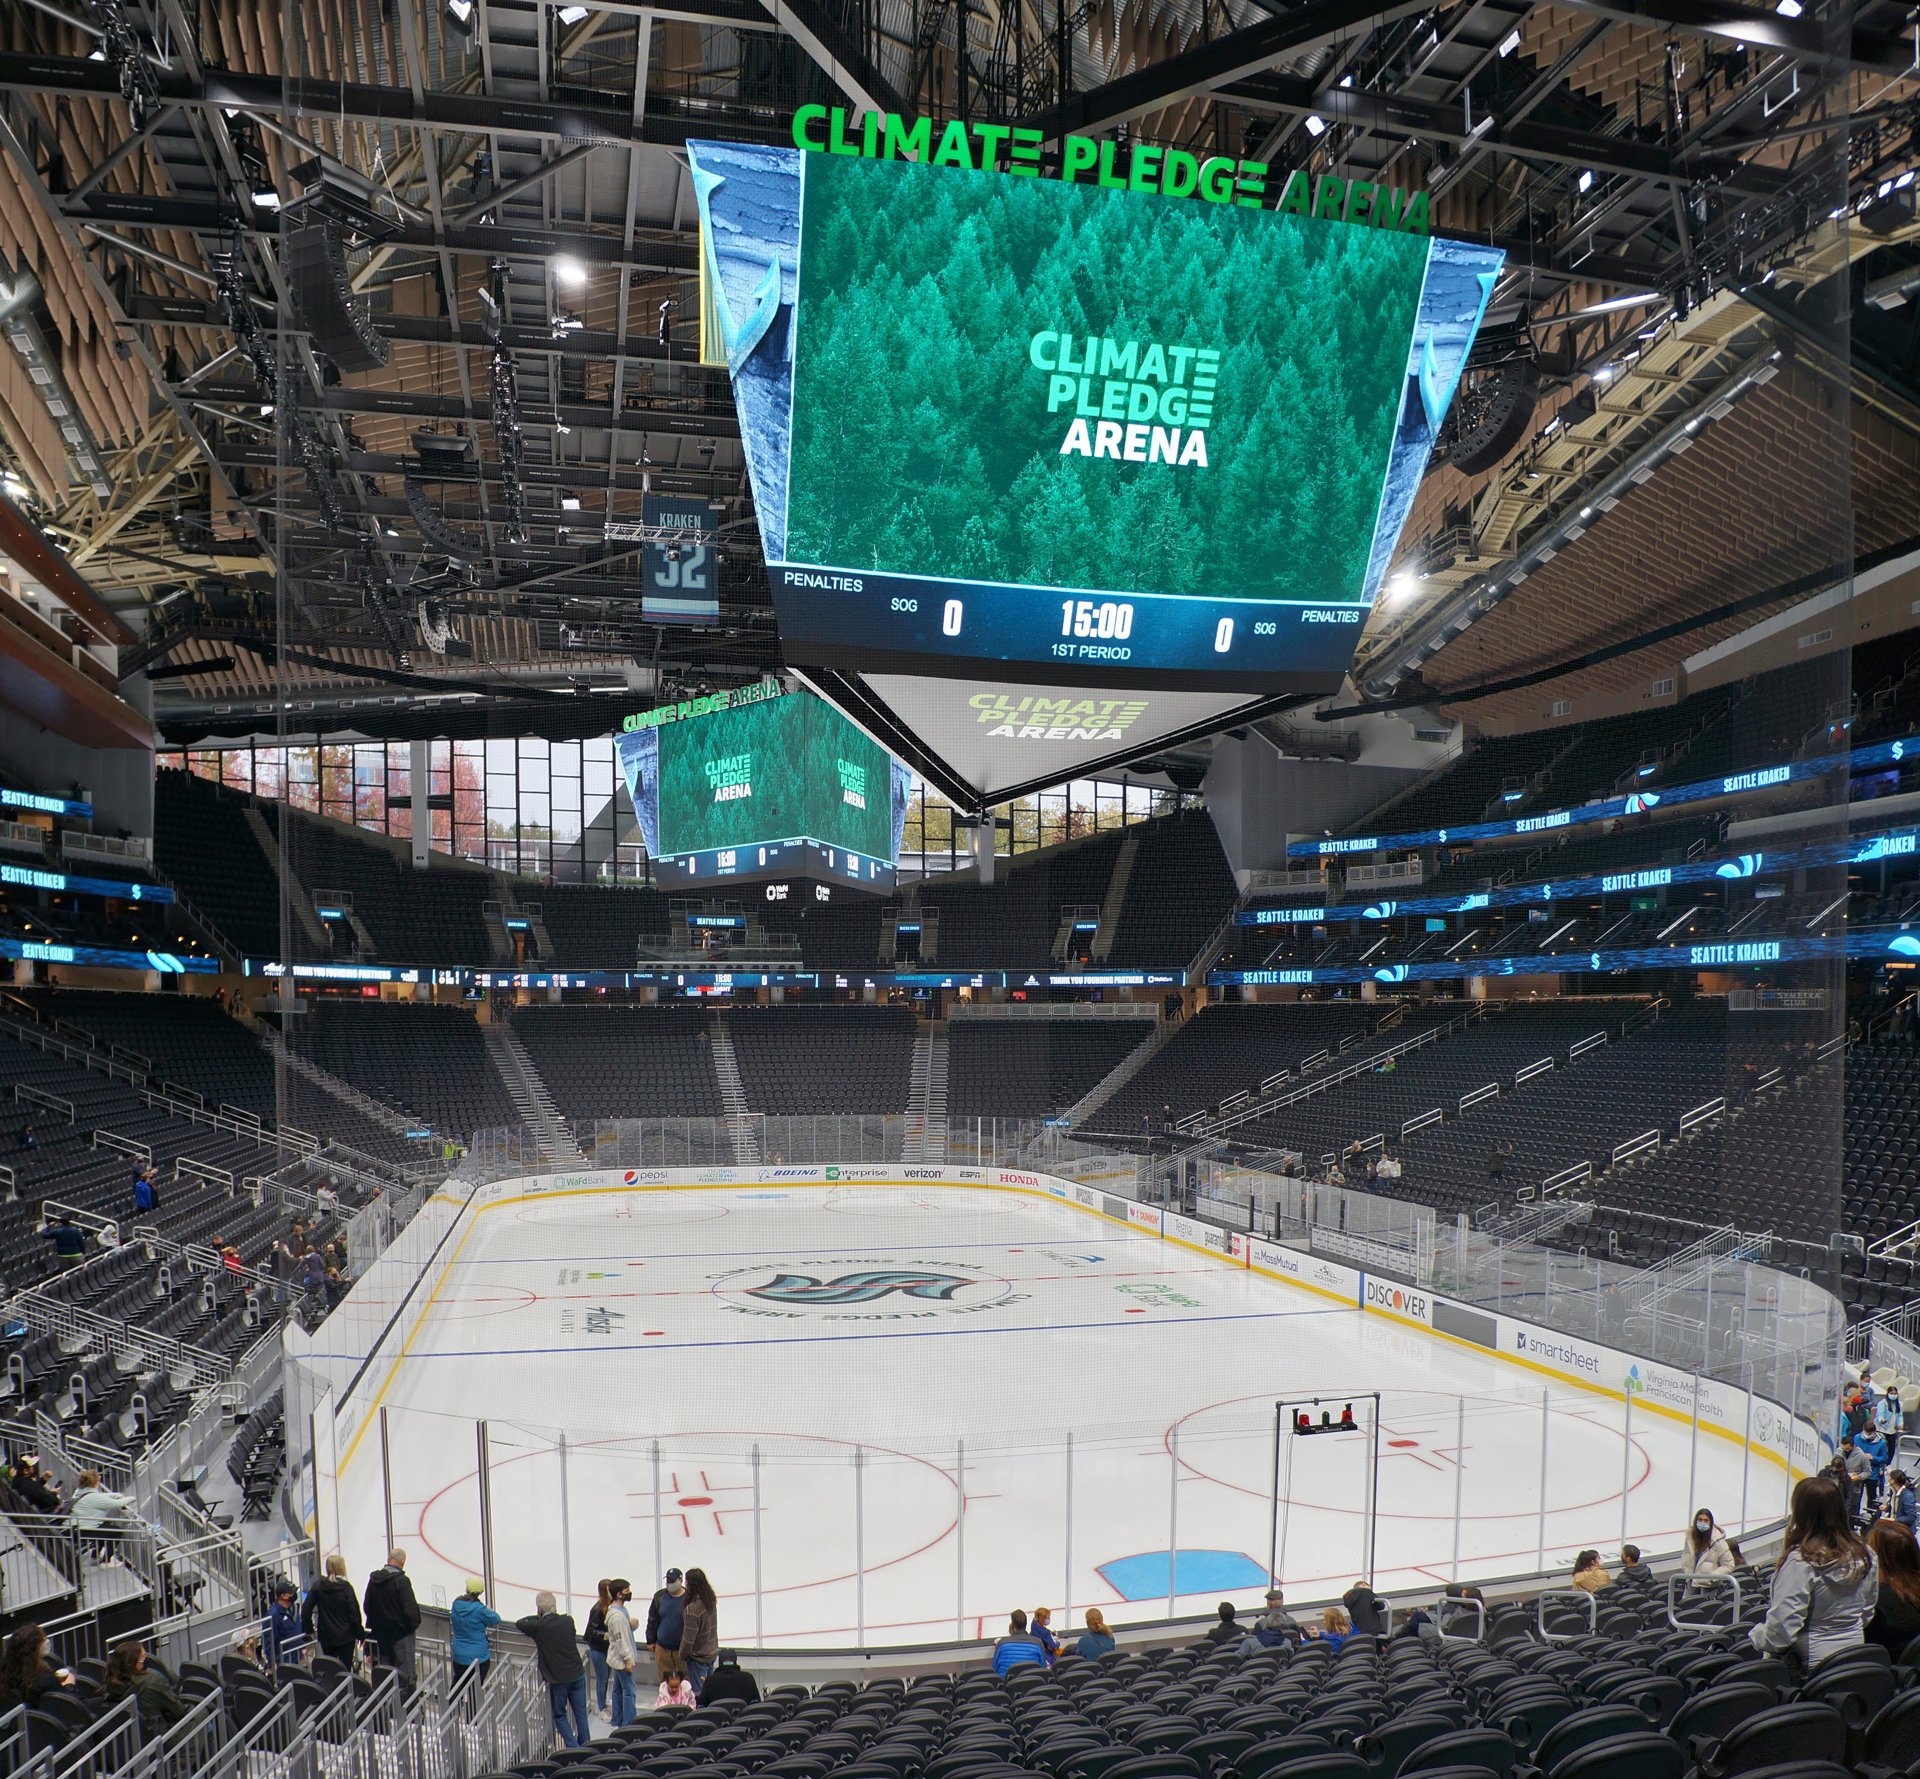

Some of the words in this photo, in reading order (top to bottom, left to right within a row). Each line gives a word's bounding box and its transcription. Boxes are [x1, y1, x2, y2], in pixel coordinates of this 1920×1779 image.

[791, 103, 1043, 177] CLIMATE
[1062, 134, 1268, 209] PLEDGE
[1275, 169, 1430, 236] ARENA
[1029, 331, 1221, 385] CLIMATE
[1047, 374, 1215, 428] PLEDGE
[1059, 418, 1209, 468] ARENA
[660, 512, 701, 529] KRAKEN
[784, 571, 863, 593] PENALTIES
[891, 597, 918, 612] SOG
[942, 599, 963, 636] 0
[1061, 599, 1134, 639] 15:00
[1301, 609, 1359, 624] PENALTIES
[1214, 617, 1234, 653] 0
[1254, 622, 1276, 635] SOG
[1051, 643, 1077, 658] 1ST
[1079, 645, 1132, 660] PERIOD
[623, 705, 676, 732] CLIMATE
[677, 691, 729, 720] PLEDGE
[730, 679, 782, 707] ARENA
[968, 693, 1150, 715] CLIMATE
[976, 709, 1140, 729] PLEDGE
[985, 724, 1122, 740] ARENA
[705, 753, 751, 776] CLIMATE
[837, 758, 865, 783] CLIMATE
[710, 767, 751, 789] PLEDGE
[840, 774, 865, 796] PLEDGE
[1724, 773, 1757, 793] SEATTLE
[1757, 766, 1790, 786] KRAKEN
[1, 789, 35, 808] SEATTLE
[34, 795, 65, 813] KRAKEN
[714, 782, 752, 803] ARENA
[843, 789, 866, 811] ARENA
[1516, 817, 1546, 833] SEATTLE
[1546, 812, 1570, 828] KRAKEN
[1319, 840, 1349, 853] SEATTLE
[1349, 838, 1377, 851] KRAKEN
[1, 865, 32, 885] SEATTLE
[34, 871, 65, 890] KRAKEN
[1602, 874, 1636, 891] SEATTLE
[1638, 868, 1672, 887] KRAKEN
[697, 917, 716, 925] SEATTLE
[717, 918, 735, 926] KRAKEN
[1257, 910, 1290, 923] SEATTLE
[1292, 909, 1324, 922] KRAKEN
[1691, 945, 1734, 963] SEATTLE
[1736, 942, 1780, 961] KRAKEN
[1050, 976, 1071, 985] THANK
[1071, 976, 1083, 984] YOU
[1243, 971, 1278, 984] SEATTLE
[1279, 970, 1312, 983] KRAKEN
[640, 1171, 668, 1182] pepsi
[774, 1169, 819, 1177] BOEING
[828, 1168, 888, 1180] enterprise
[904, 1168, 941, 1179] verizon
[1000, 1174, 1039, 1186] HONDA
[1260, 1249, 1298, 1272] MassMutual
[1367, 1281, 1426, 1318] DISCOVER
[1530, 1338, 1599, 1373] smartsheet
[1647, 1369, 1679, 1390] Virginia
[1680, 1382, 1709, 1399] Maon
[1647, 1385, 1692, 1407] Franciscan
